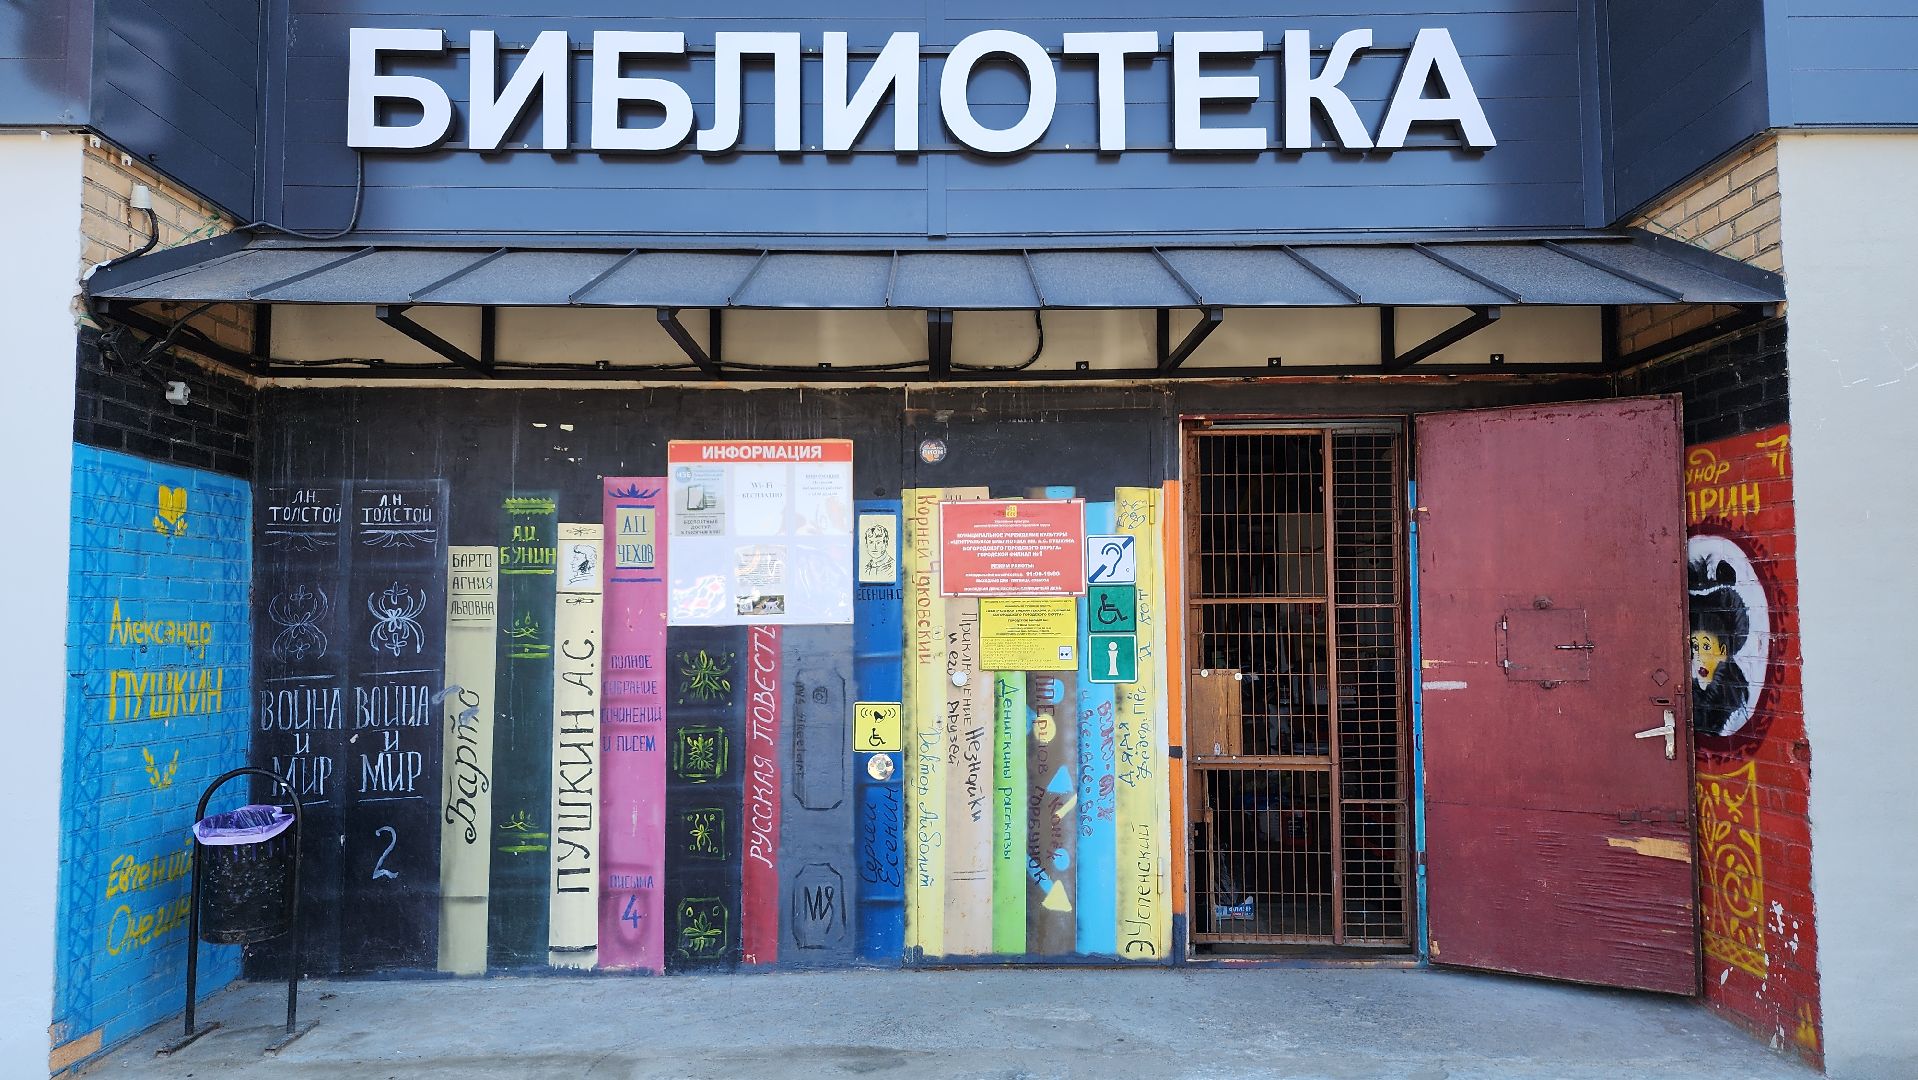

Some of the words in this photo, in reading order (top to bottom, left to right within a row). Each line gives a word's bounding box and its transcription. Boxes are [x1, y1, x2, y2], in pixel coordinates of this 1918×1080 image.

[347, 27, 1498, 154] БИБЛИОТЕКА
[702, 445, 821, 461] ИНФОРМАЦИЯ
[268, 503, 342, 524] ТОЛСТОЙ
[292, 490, 320, 503] Л.Н.
[361, 504, 432, 523] ТОЛСТОЙ
[379, 494, 407, 506] Л.Н.
[512, 525, 540, 542] А.И.
[909, 494, 938, 559] Корней
[452, 553, 492, 567] БАРТО
[500, 546, 557, 565] БУНИН
[616, 543, 654, 564] ЧЕХОВ
[452, 576, 493, 589] АГНИЯ
[109, 597, 212, 659] Александр
[451, 600, 495, 615] ЛЬВОВНА
[562, 630, 595, 696] А.С.
[611, 655, 652, 669] ПОЛНОЕ
[109, 666, 223, 721] ПУШКИН
[353, 681, 430, 730] ВОЙНА
[603, 680, 658, 695] СОБРАНИЕ
[753, 625, 777, 746] ПОВЕСТЬ
[260, 684, 342, 730] ВОЙНА
[601, 702, 662, 723] СОЧИНЕНИЙ
[617, 736, 656, 752] ПИСЕМ
[998, 678, 1020, 779] Денискины
[272, 757, 333, 797] МИР
[357, 751, 423, 793] МИР
[445, 688, 489, 845] Барто
[911, 722, 941, 796] Доктор
[965, 726, 985, 823] Незнайки
[557, 709, 594, 894] ПУШКИН
[750, 752, 774, 869] РУССКАЯ
[878, 786, 901, 888] Есенин
[998, 786, 1013, 860] рассказы
[373, 826, 399, 880] 2
[608, 875, 654, 889] ПИСЬМА
[622, 894, 642, 929] 4
